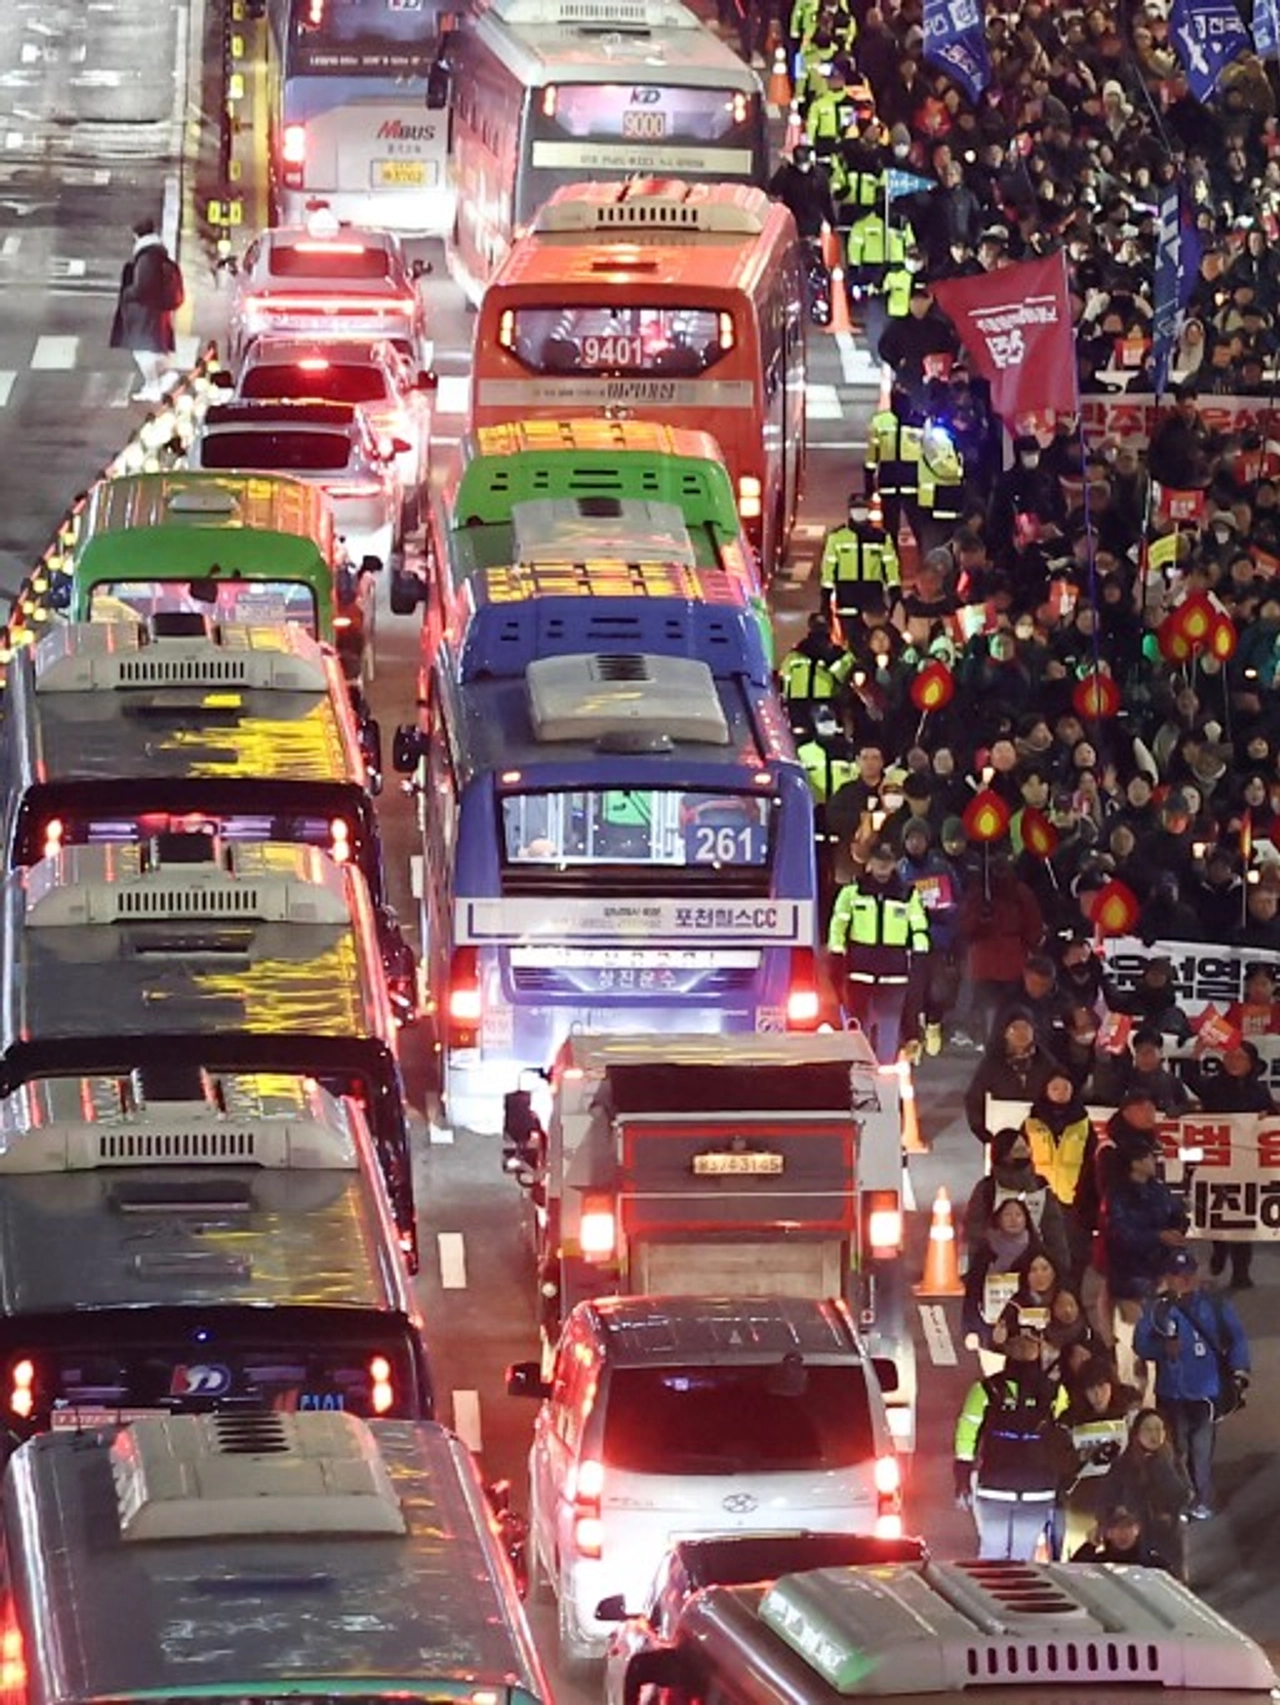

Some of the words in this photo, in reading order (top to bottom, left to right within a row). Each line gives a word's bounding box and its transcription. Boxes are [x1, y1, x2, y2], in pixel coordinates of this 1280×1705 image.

[625, 112, 665, 138] 9000
[585, 337, 643, 364] 9401
[694, 826, 754, 862] 261
